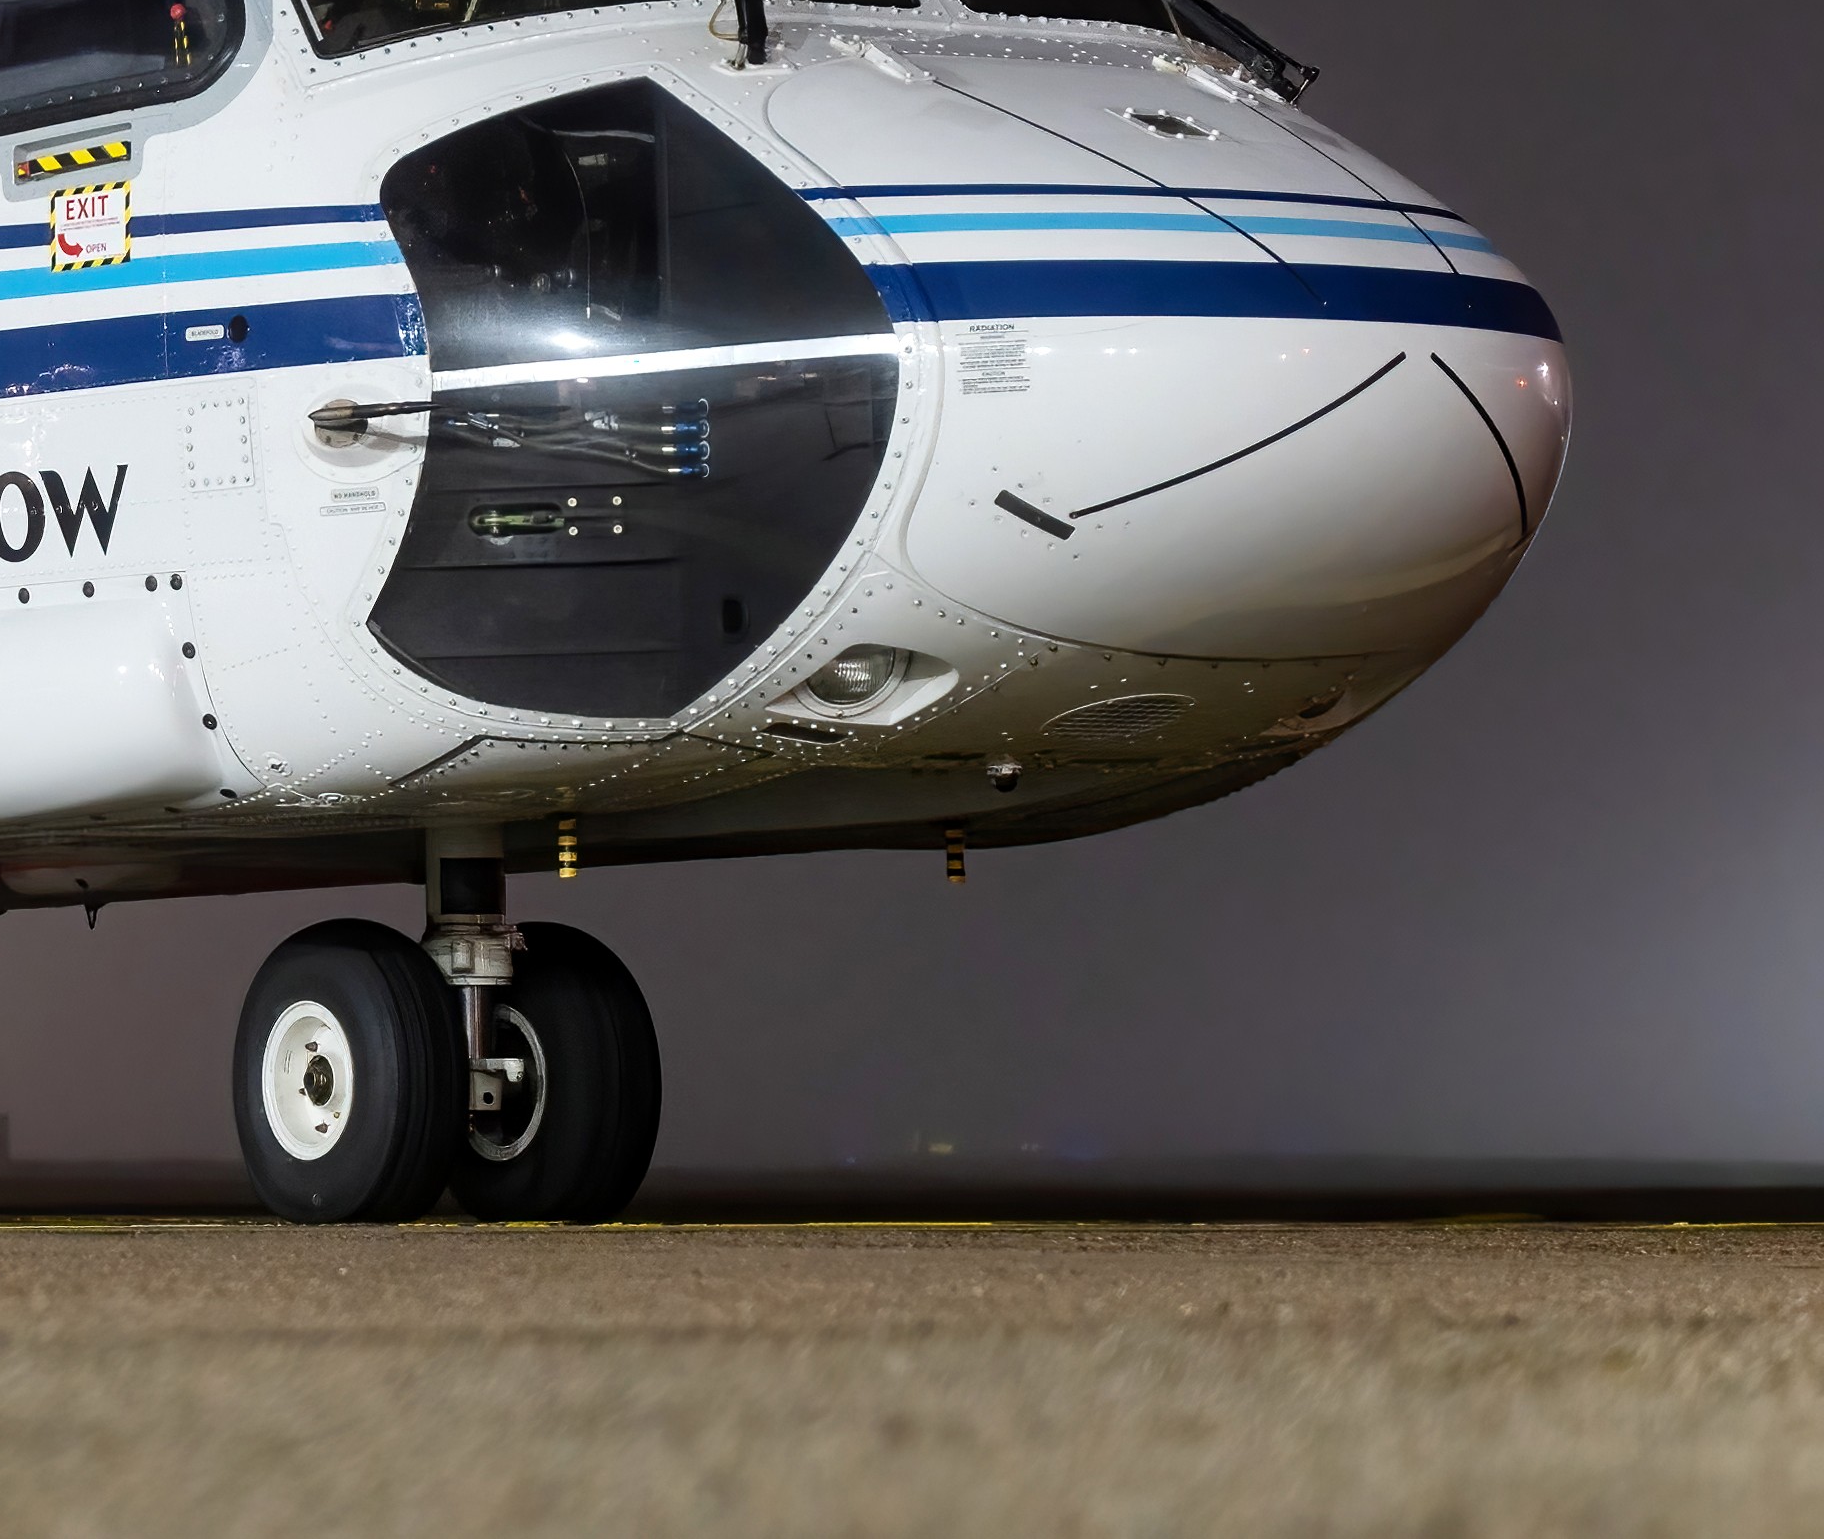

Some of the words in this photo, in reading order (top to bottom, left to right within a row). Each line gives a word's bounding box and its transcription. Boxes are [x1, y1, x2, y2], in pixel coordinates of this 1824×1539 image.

[66, 194, 109, 221] EXIT
[85, 242, 107, 254] OPEN
[969, 323, 1015, 332] RADIATION
